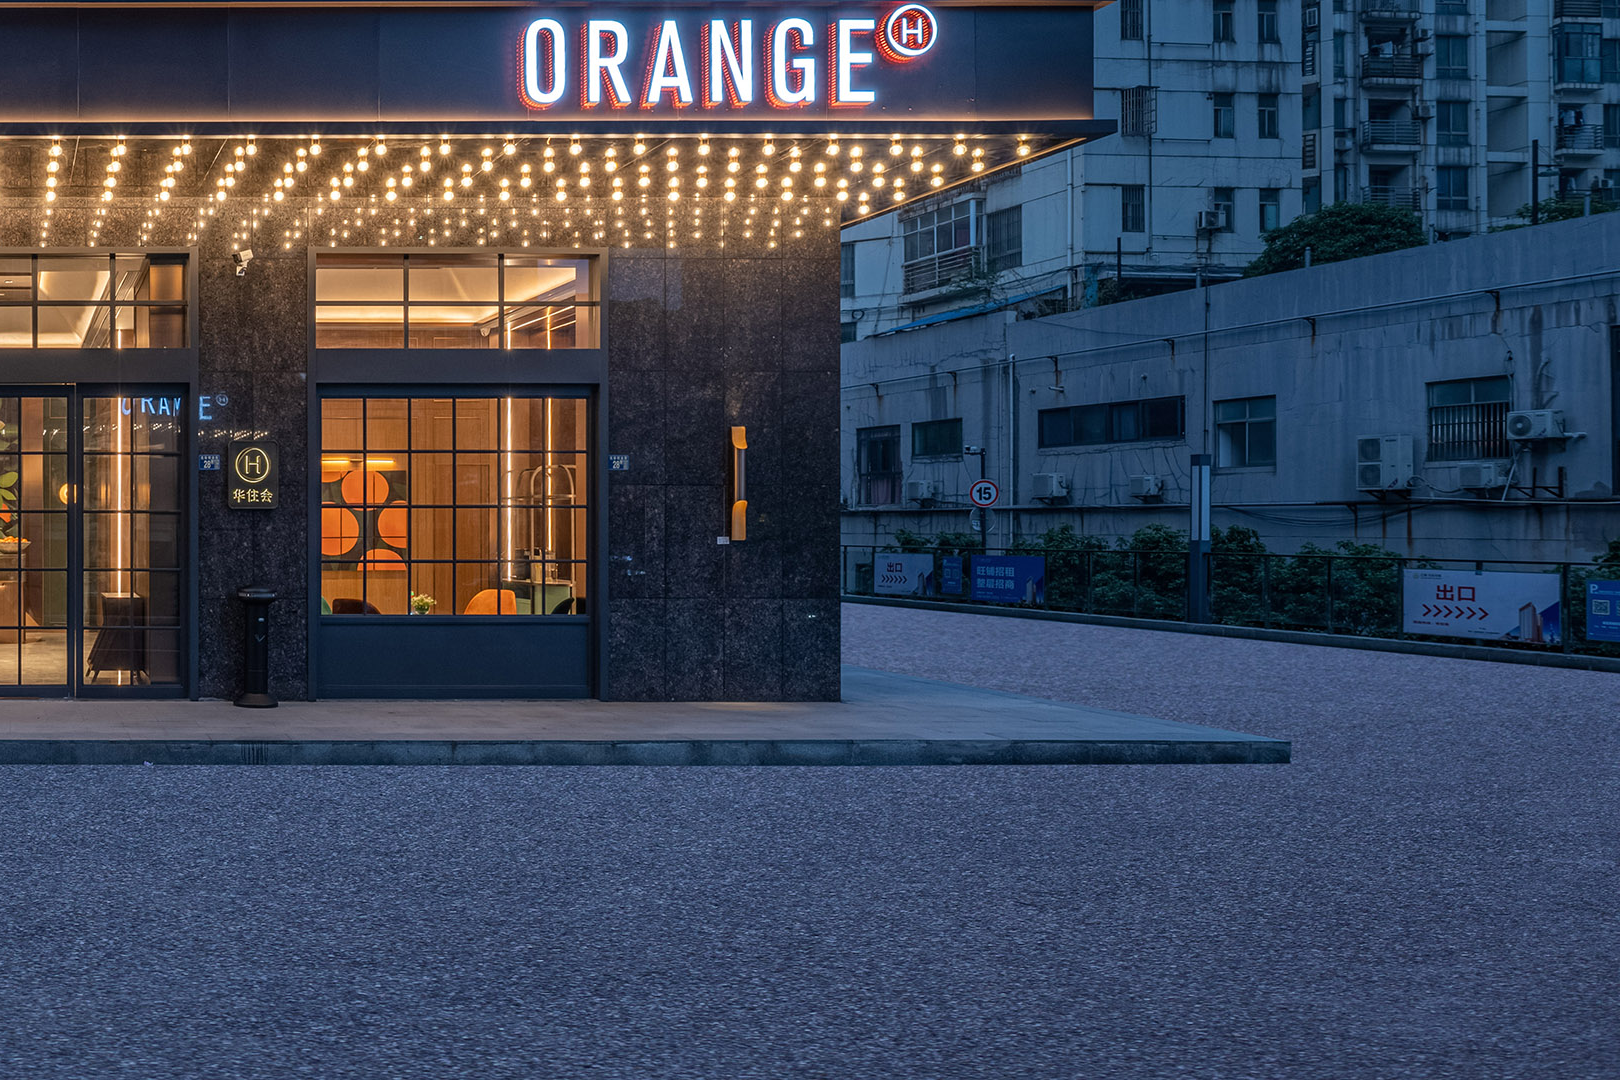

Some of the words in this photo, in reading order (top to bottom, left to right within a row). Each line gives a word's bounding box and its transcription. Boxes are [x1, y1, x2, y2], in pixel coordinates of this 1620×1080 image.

[524, 18, 876, 104] ORANGE
[232, 488, 273, 503] 华住会
[976, 487, 992, 500] 15
[886, 562, 902, 573] 出口
[1436, 584, 1476, 602] 出口
